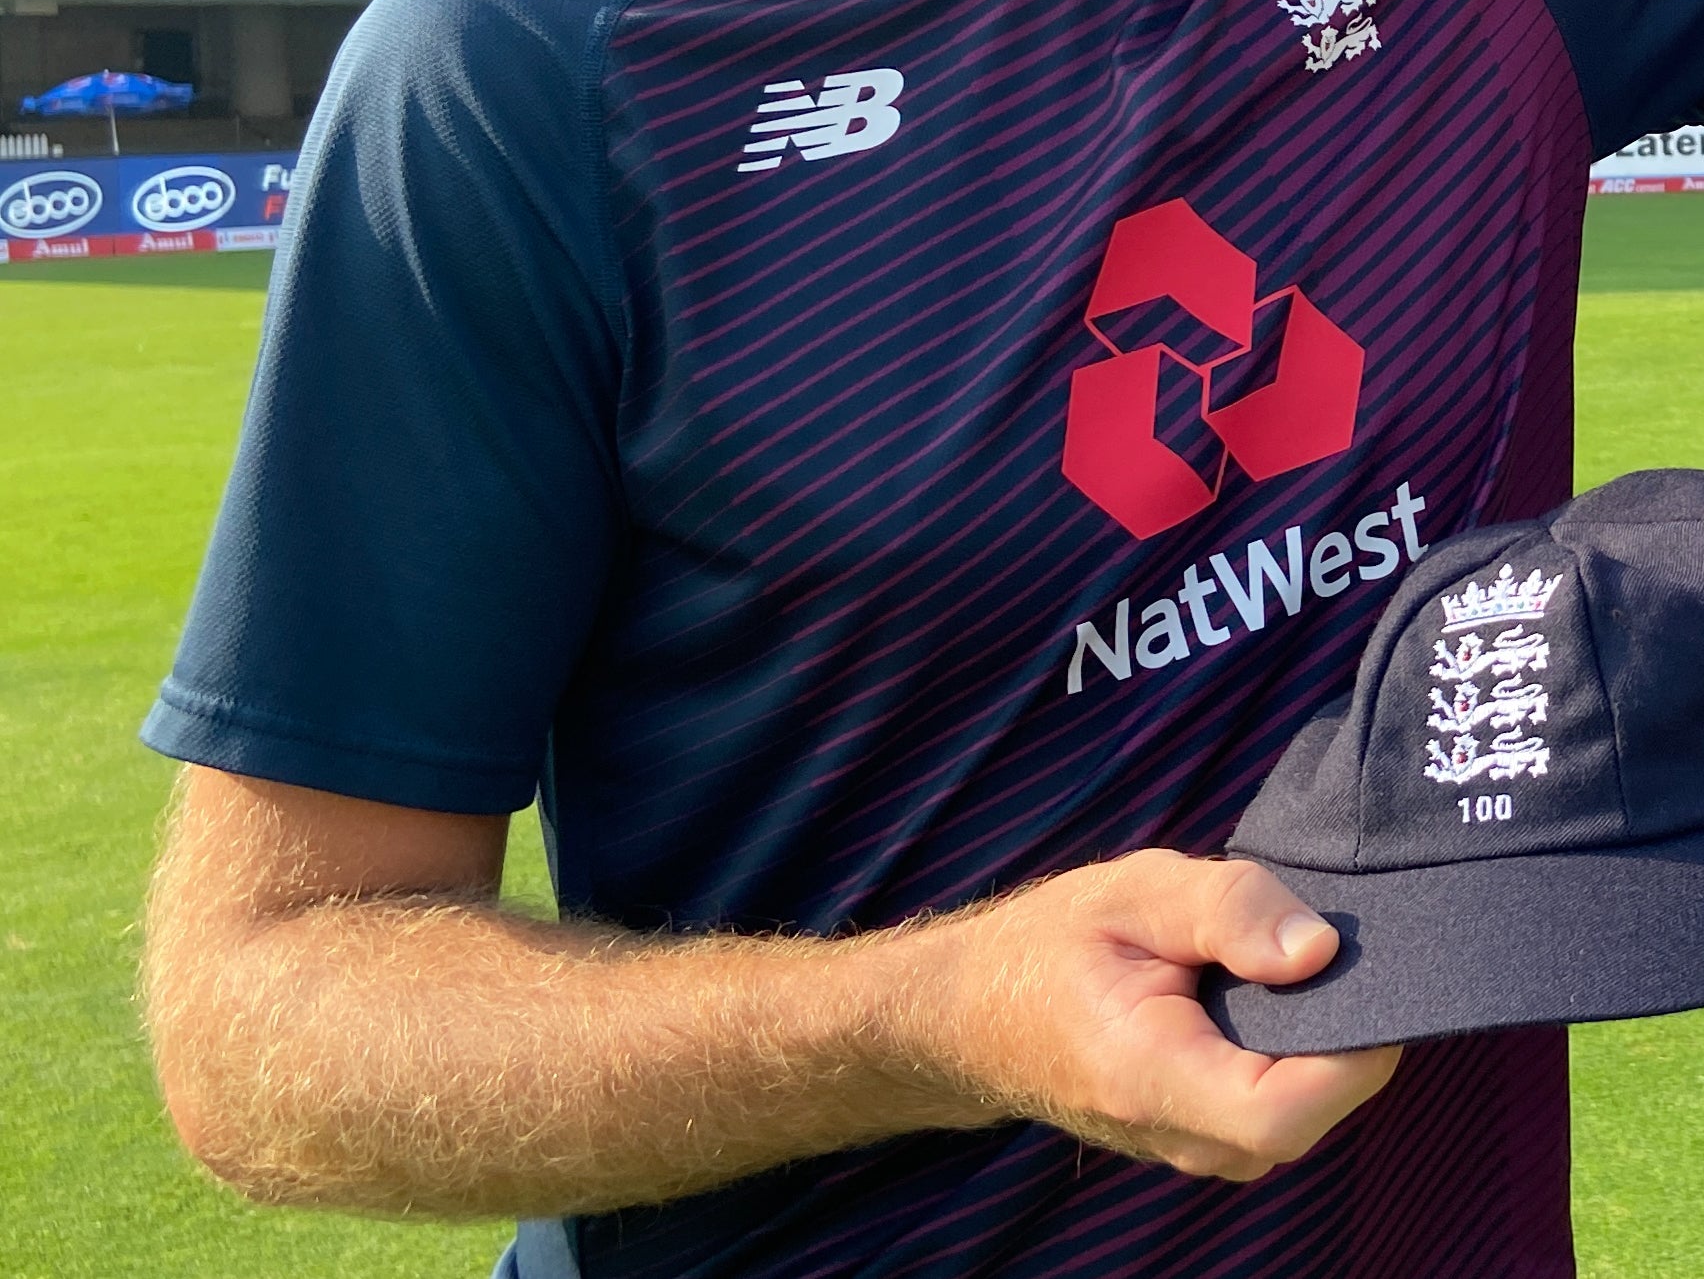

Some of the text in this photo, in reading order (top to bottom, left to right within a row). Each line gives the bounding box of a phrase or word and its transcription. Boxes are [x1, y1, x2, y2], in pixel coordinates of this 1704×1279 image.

[1602, 178, 1636, 193] ACC
[33, 238, 90, 258] Amul
[138, 232, 195, 252] Amul
[1067, 482, 1429, 695] NatWest
[1458, 793, 1513, 823] 100
